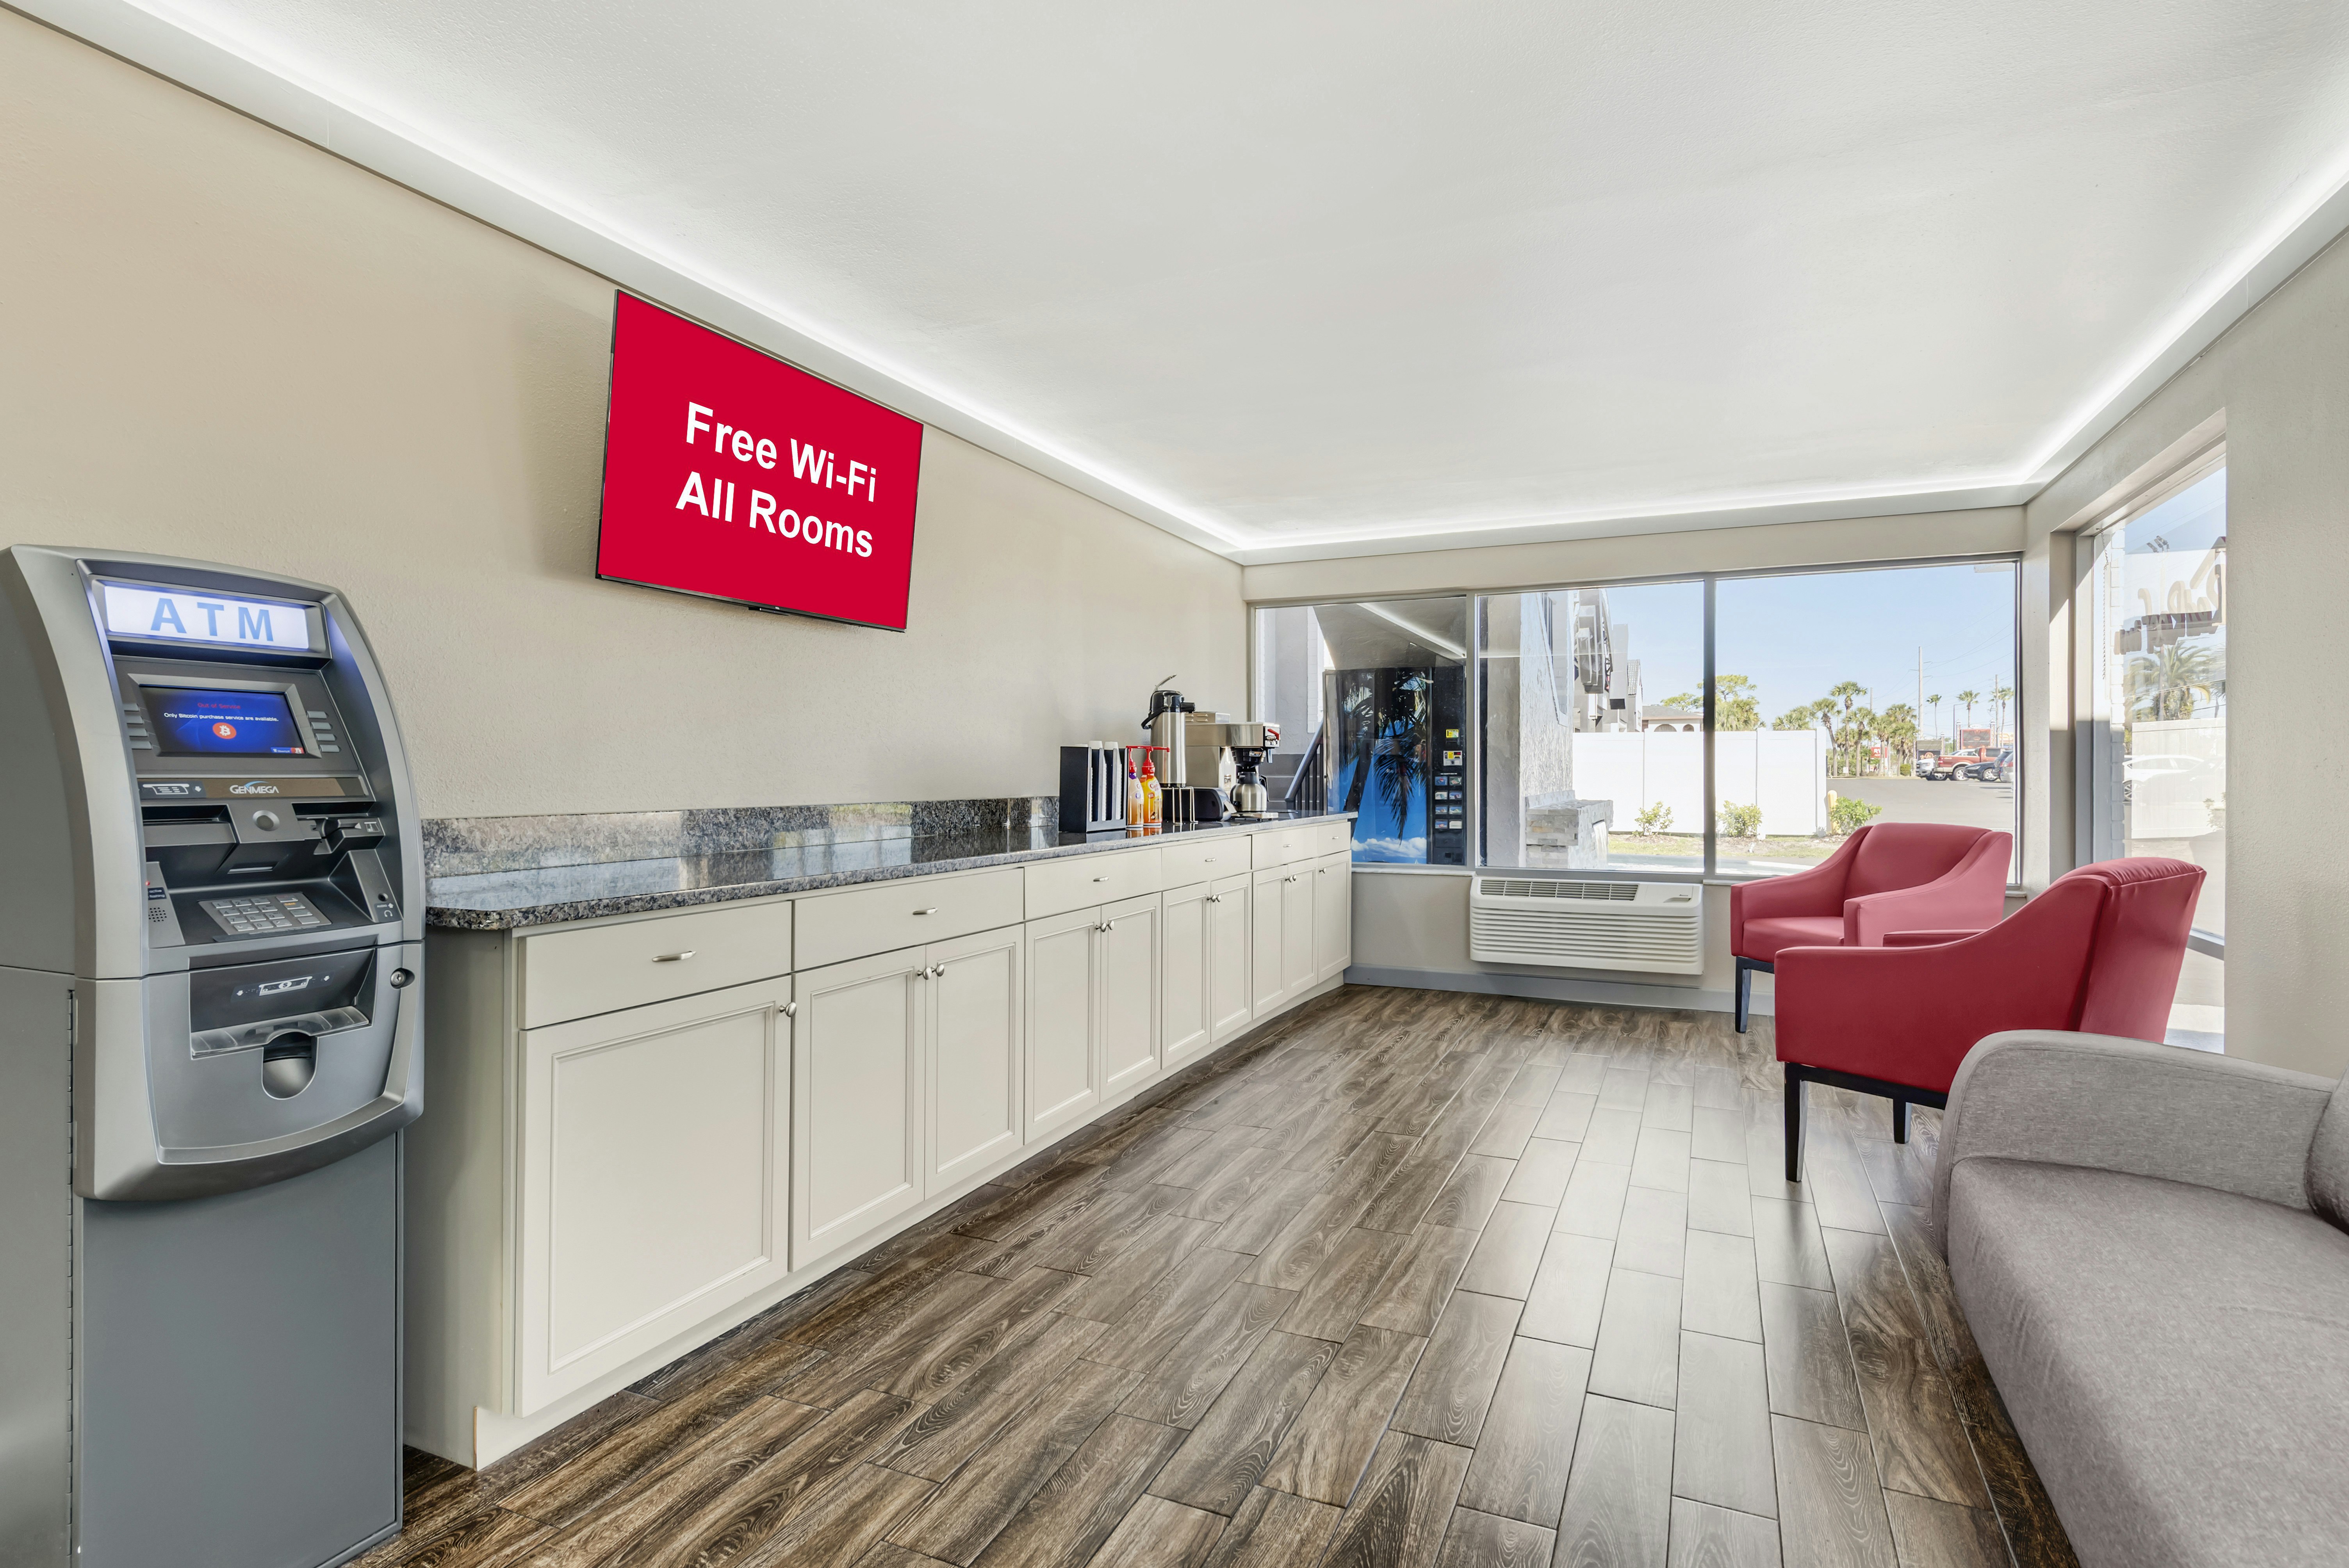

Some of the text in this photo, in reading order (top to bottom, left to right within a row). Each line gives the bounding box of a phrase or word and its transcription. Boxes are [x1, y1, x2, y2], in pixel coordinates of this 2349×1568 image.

[686, 402, 876, 502] Free Wi-Fi
[675, 471, 873, 558] All Rooms
[150, 598, 274, 642] ATM
[229, 785, 279, 794] GENMEGA
